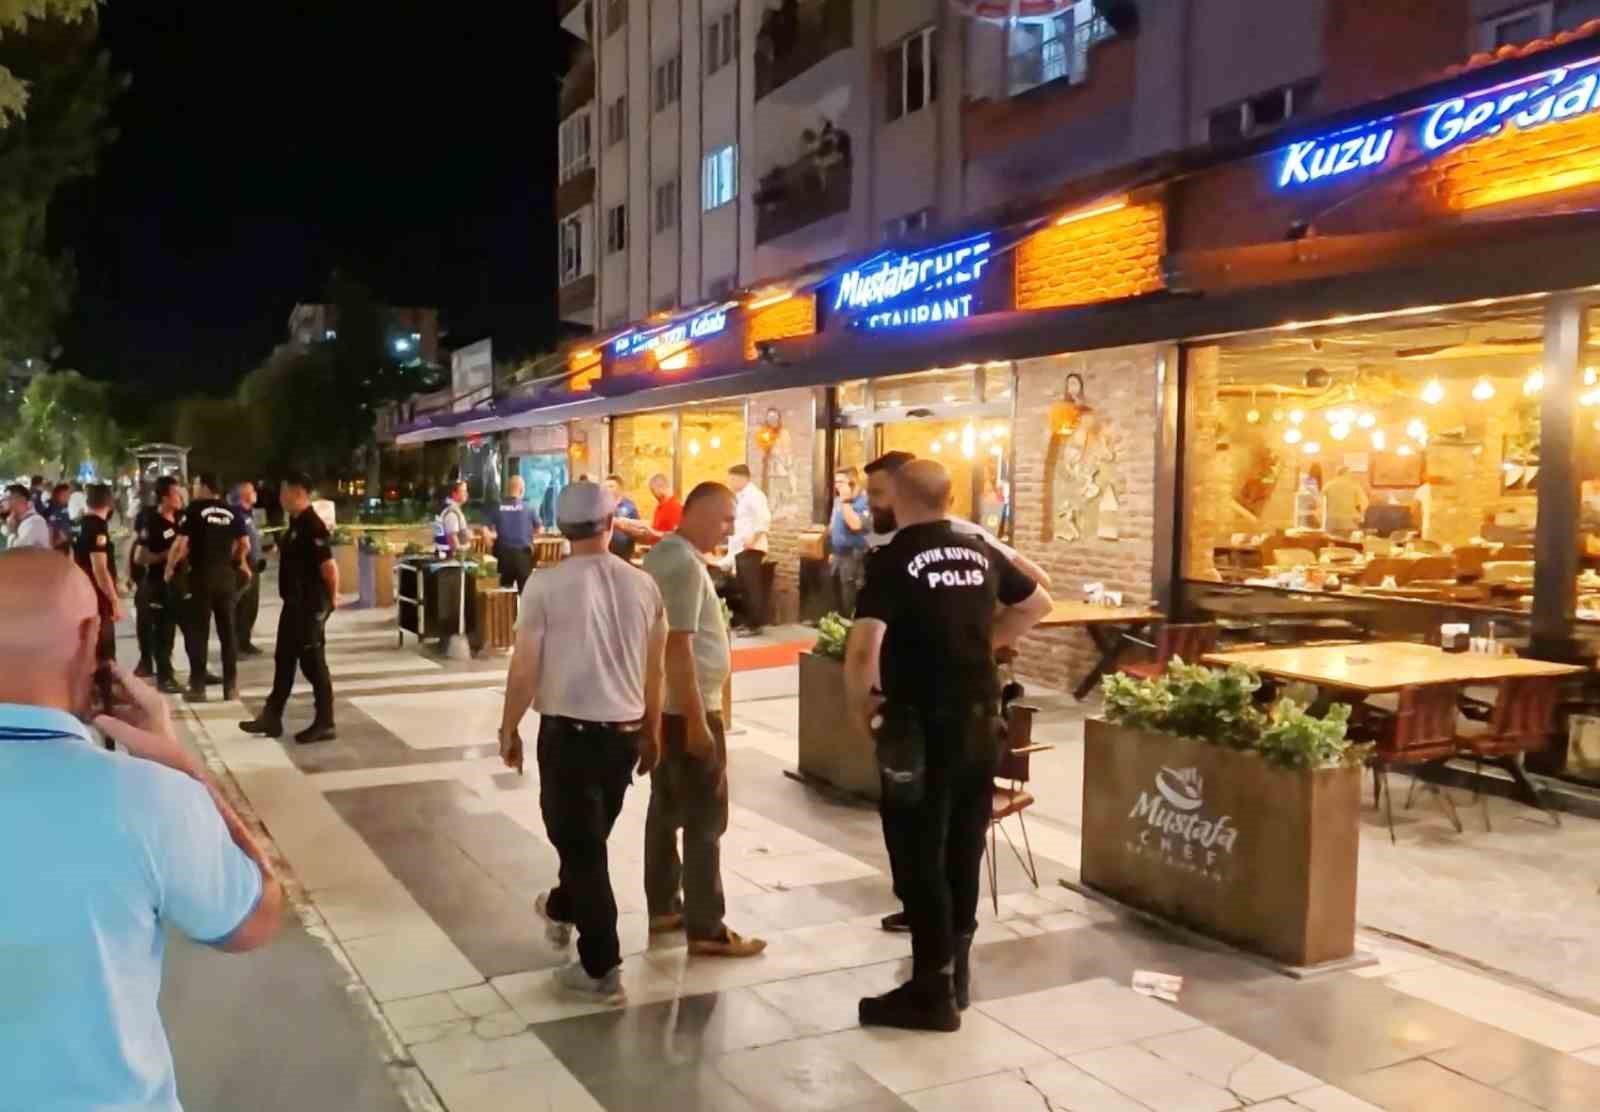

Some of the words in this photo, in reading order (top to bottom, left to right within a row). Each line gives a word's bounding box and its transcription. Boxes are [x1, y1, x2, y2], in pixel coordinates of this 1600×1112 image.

[1278, 128, 1394, 188] Kuzu
[1423, 68, 1600, 150] Gerda
[834, 255, 920, 311] Mustafa
[1128, 791, 1239, 854] Mustafa
[1140, 829, 1217, 866] CHEF
